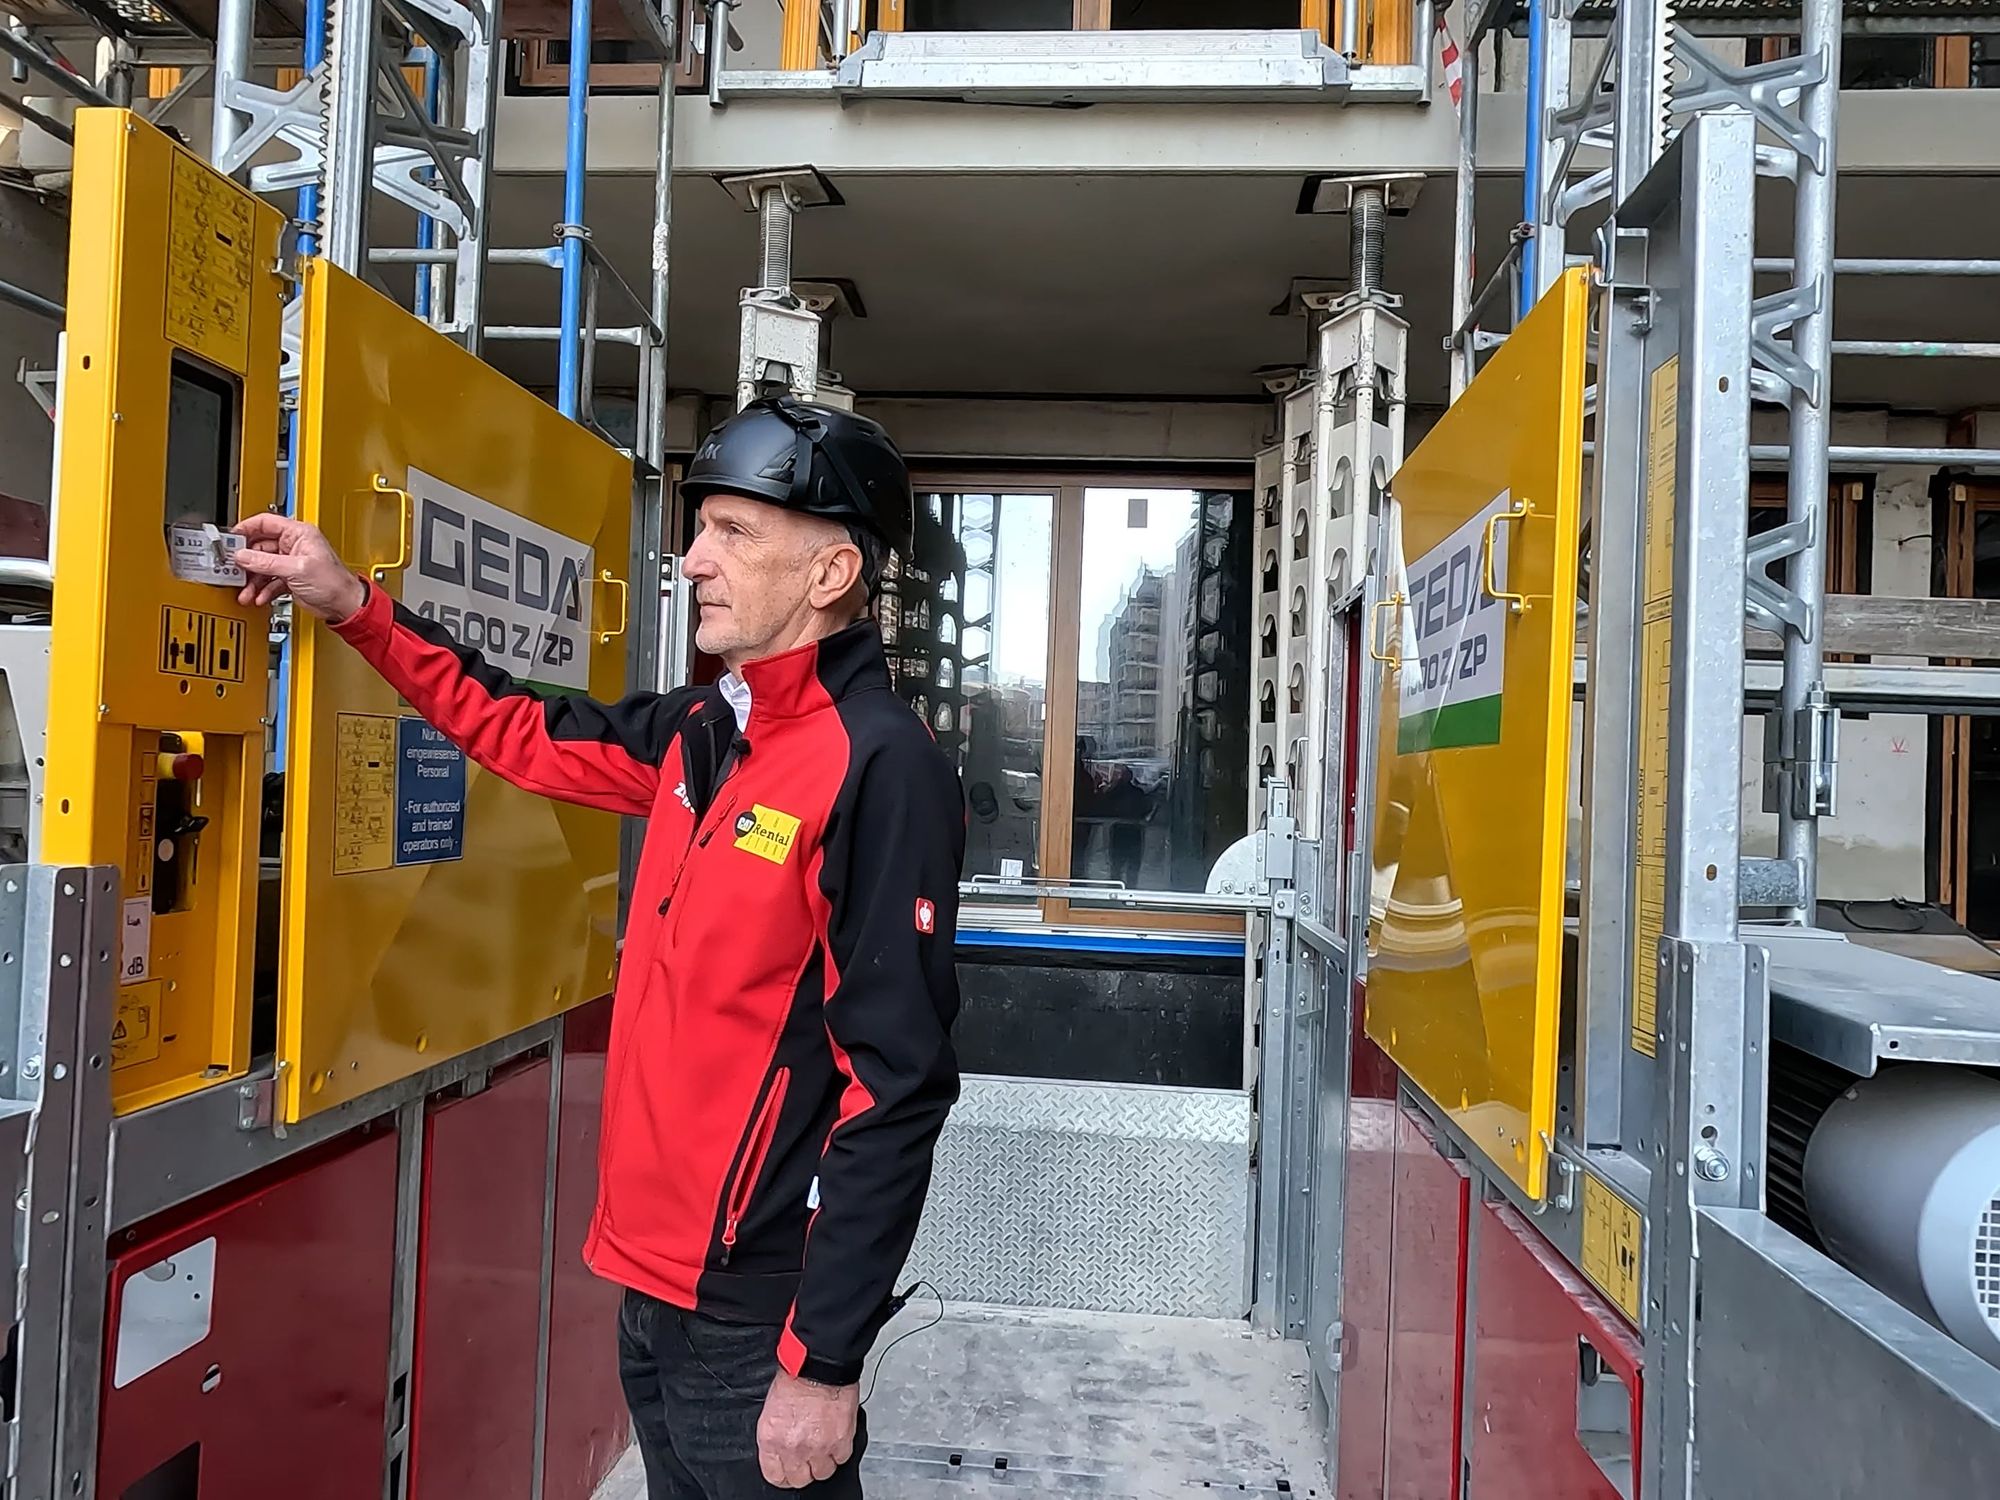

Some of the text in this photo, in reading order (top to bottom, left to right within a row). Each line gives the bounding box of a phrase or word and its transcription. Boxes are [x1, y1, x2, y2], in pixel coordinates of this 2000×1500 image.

[420, 498, 582, 622] GEDA
[512, 624, 573, 667] Z/ZP
[422, 727, 436, 741] Nur
[407, 746, 460, 762] eingewiesenes
[417, 764, 449, 778] Personal
[423, 800, 460, 813] authorized
[412, 818, 453, 832] and trained
[753, 824, 790, 846] Rental
[403, 838, 439, 854] operators
[440, 837, 455, 851] only
[127, 956, 144, 976] dB
